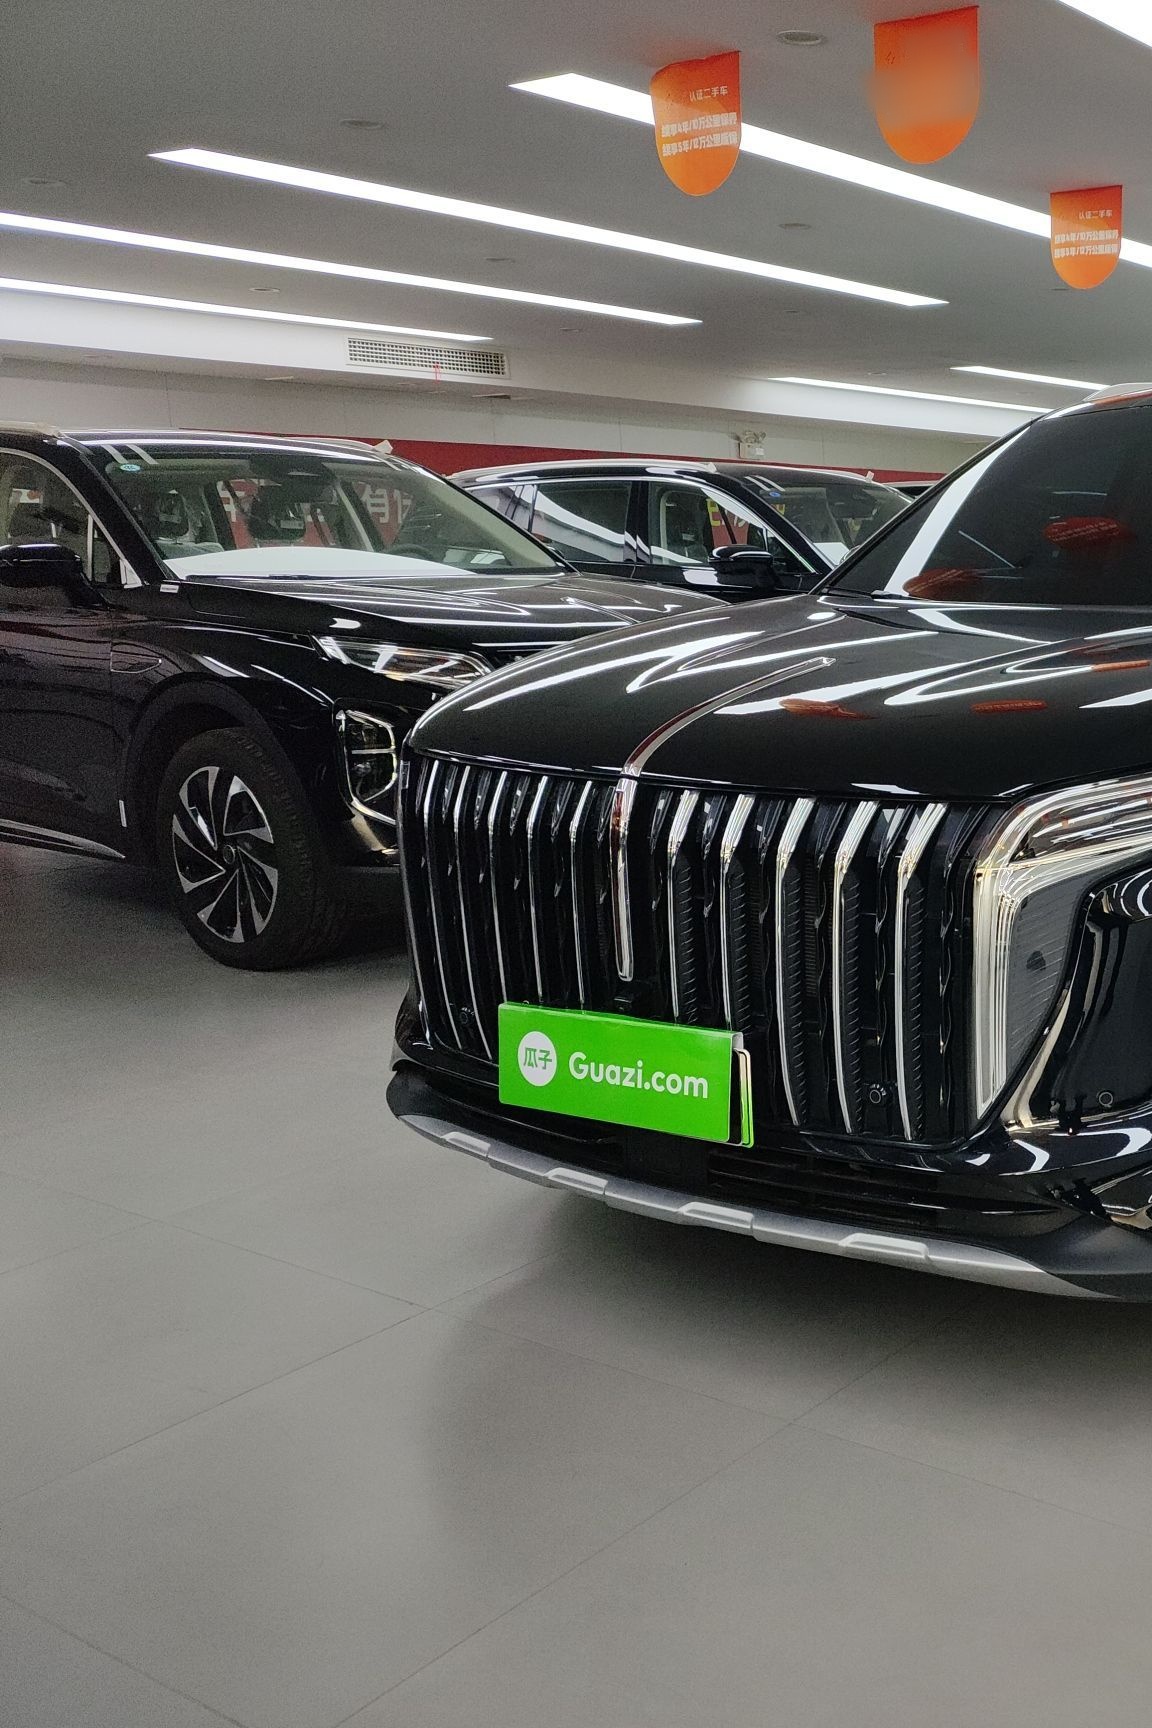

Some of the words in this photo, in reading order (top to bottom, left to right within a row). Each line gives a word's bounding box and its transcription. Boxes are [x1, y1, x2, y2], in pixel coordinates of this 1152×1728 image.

[690, 85, 728, 102] 认证二手车
[523, 1047, 553, 1070] 瓜子
[568, 1051, 709, 1100] Guazi.com
